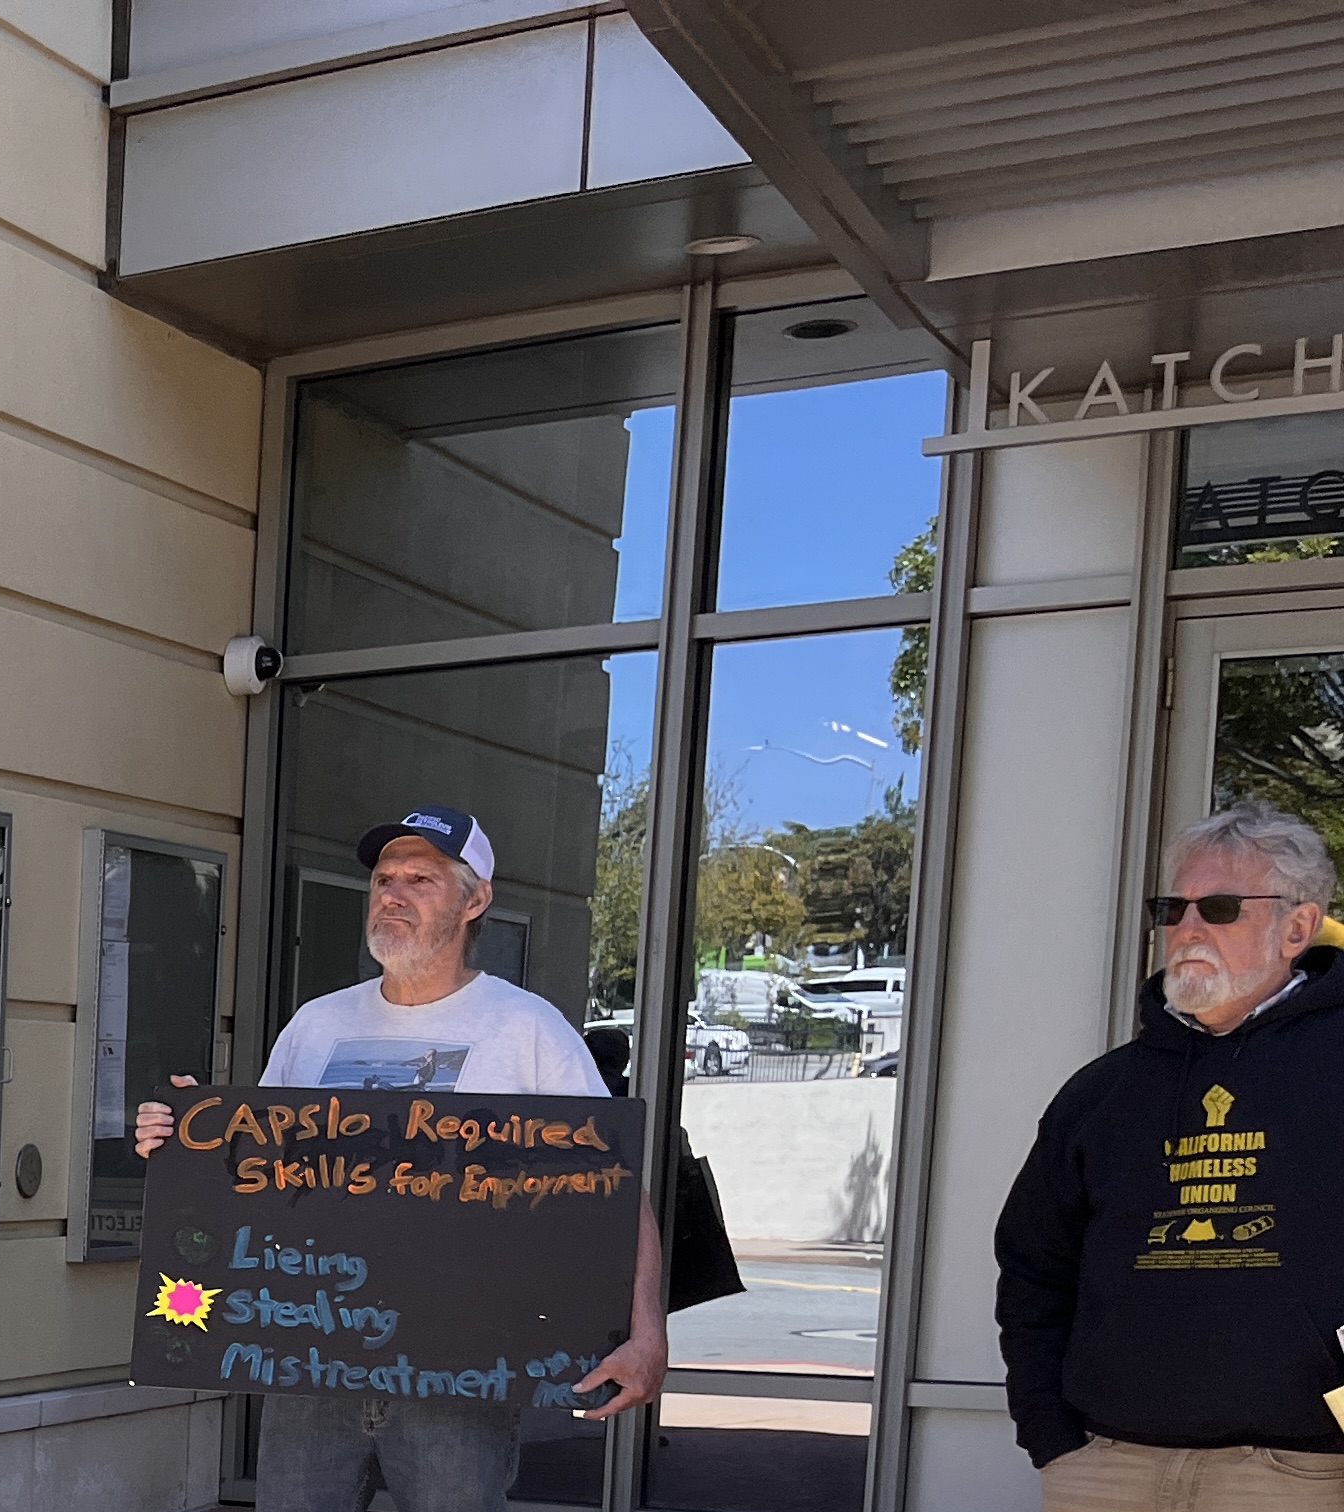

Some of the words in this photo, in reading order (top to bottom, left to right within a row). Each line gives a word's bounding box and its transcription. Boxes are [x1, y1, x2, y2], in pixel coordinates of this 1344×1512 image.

[1009, 333, 1344, 427] KATCH
[405, 1099, 610, 1151] Required
[389, 1162, 453, 1201] for
[1169, 1157, 1257, 1184] HOMELESS
[1180, 1184, 1237, 1205] UNION
